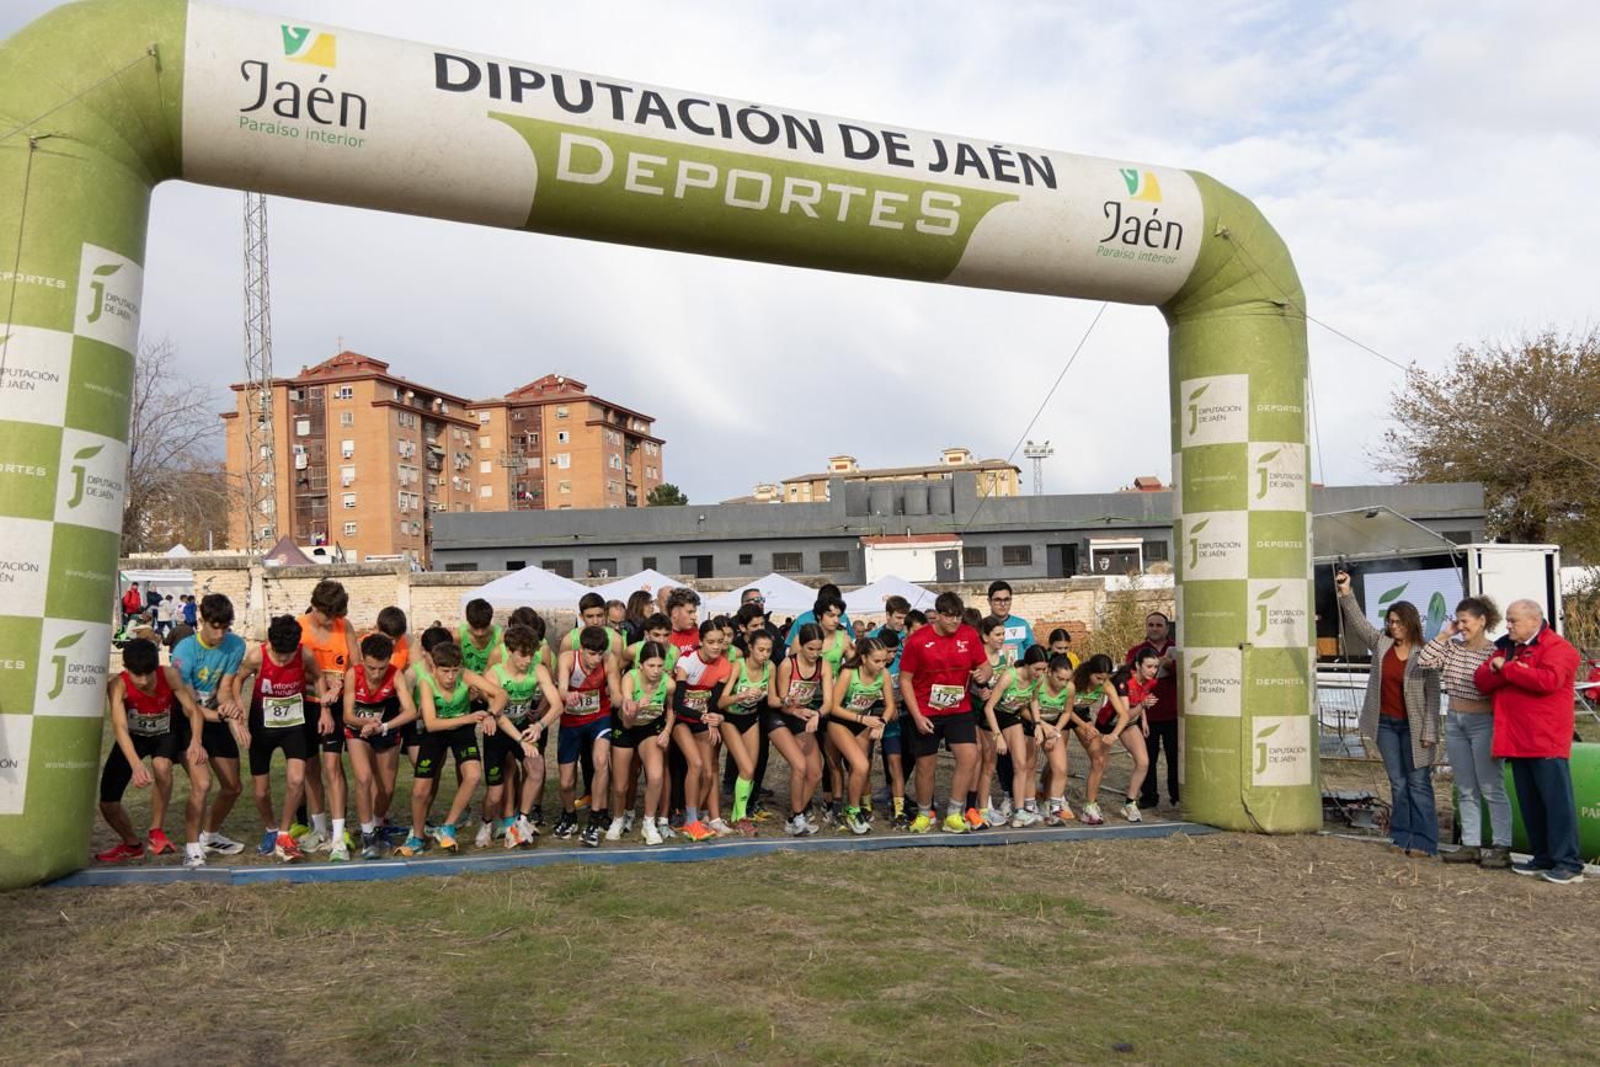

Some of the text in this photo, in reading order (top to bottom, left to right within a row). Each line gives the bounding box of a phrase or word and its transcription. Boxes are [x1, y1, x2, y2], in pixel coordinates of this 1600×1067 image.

[240, 60, 367, 130] Jaén
[434, 52, 1057, 190] DIPUTACIÓN DE JAÉN
[305, 127, 365, 149] interior
[556, 132, 962, 237] DEPORTES
[1100, 201, 1184, 251] Jaén
[7, 379, 36, 391] JAÉN
[1198, 404, 1242, 416] DIPUTACIÓN
[1257, 403, 1302, 414] DEPORTES
[1198, 414, 1227, 424] DE JAÉN
[86, 486, 98, 496] DE
[1199, 540, 1242, 550] DIPUTACIÓN
[1199, 549, 1227, 558] DE JAÉN
[66, 675, 79, 685] DE
[1199, 677, 1241, 686] DIPUTACIÓN
[1199, 685, 1226, 694] DE JAÉN
[936, 692, 958, 704] 175
[273, 705, 290, 717] 87
[137, 719, 157, 729] 94
[1269, 746, 1308, 755] DIPUTACIÓN
[1269, 755, 1278, 764] DE
